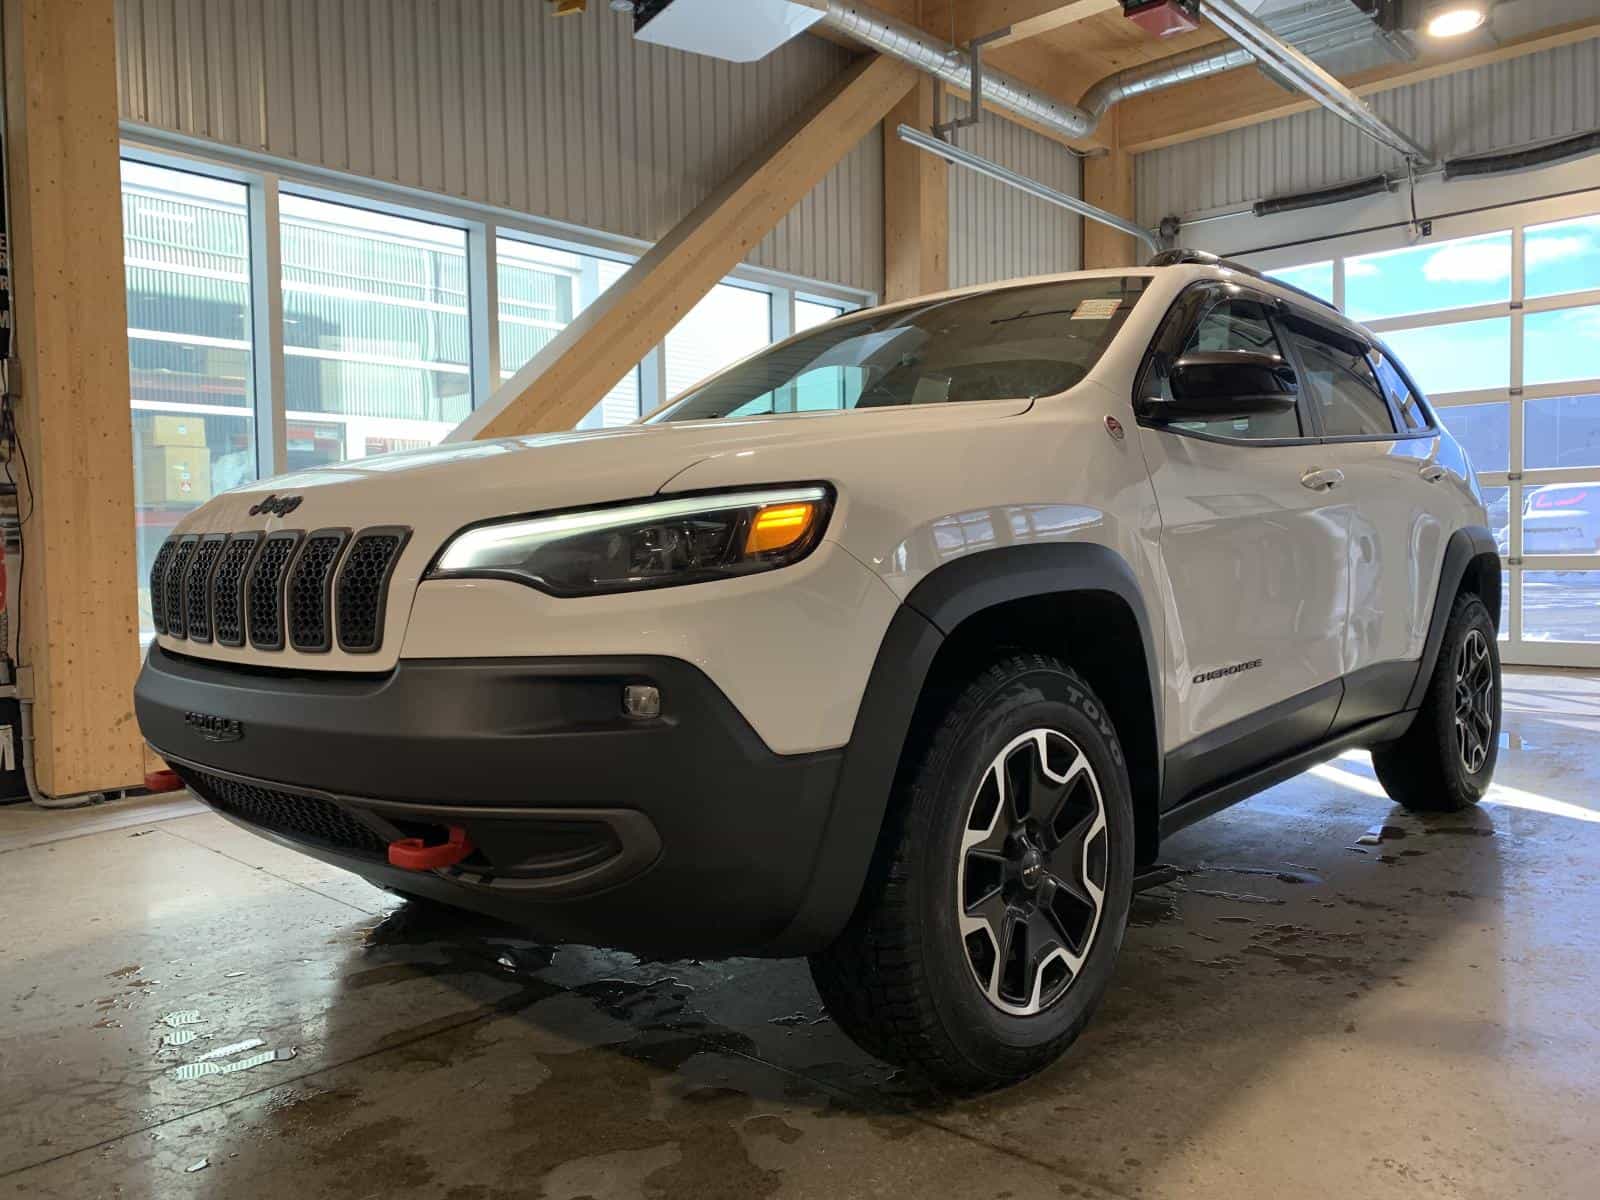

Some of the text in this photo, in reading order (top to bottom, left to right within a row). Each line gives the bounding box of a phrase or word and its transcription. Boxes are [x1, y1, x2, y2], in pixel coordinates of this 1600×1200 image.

[249, 494, 304, 518] Jeep
[1192, 658, 1264, 684] CHEROKEE
[1066, 685, 1123, 767] TOYO
